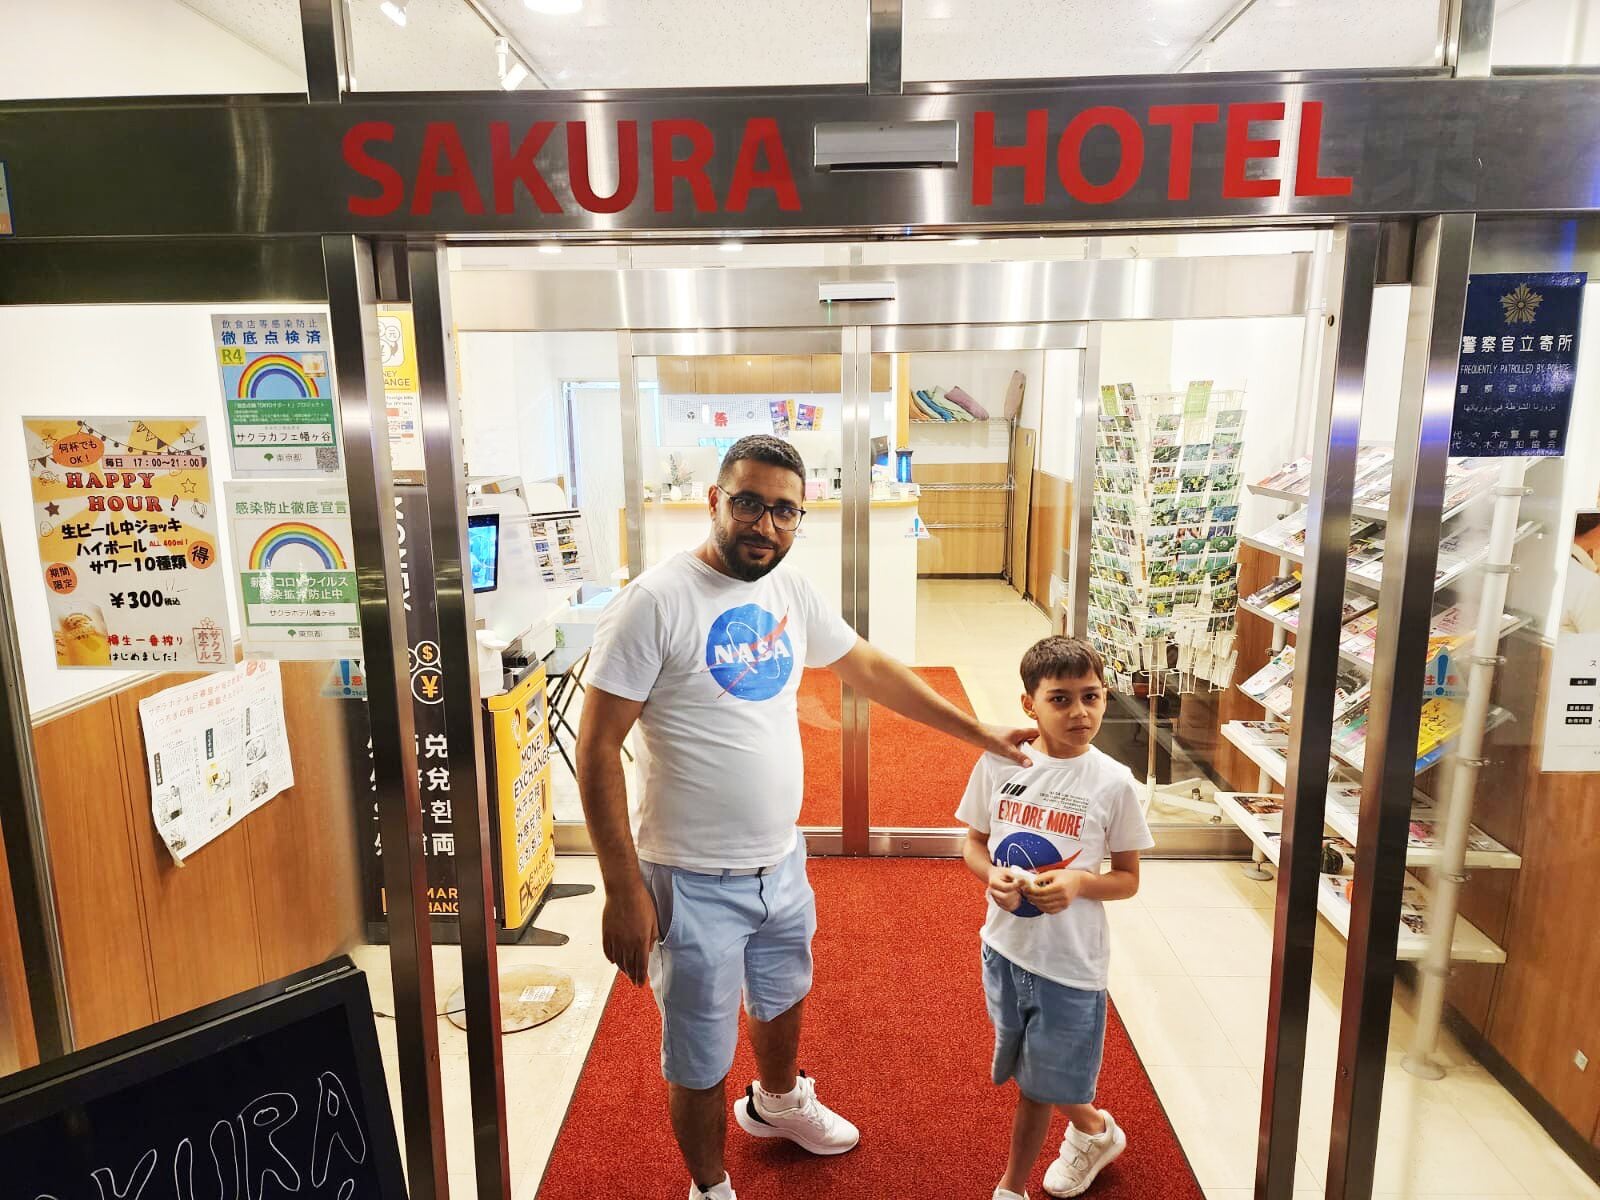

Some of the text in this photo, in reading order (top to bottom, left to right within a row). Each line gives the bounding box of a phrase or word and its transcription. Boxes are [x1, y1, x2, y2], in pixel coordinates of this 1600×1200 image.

[345, 101, 1353, 215] SAKURA HOTEL
[221, 330, 321, 345] 徹底点検済
[1462, 334, 1573, 354] 警察官立寄所
[222, 348, 242, 362] R4
[383, 370, 397, 378] NEY
[1460, 364, 1497, 374] FREQUENTLY
[1500, 364, 1534, 374] PATROLLED
[384, 378, 410, 387] ANGE
[237, 431, 331, 442] サクラカフェ幡ヶ谷
[58, 439, 98, 453] 何杯でも
[105, 458, 123, 468] 毎日
[65, 472, 155, 489] HAPPY
[235, 501, 347, 515] 感染防止徹底宣言
[61, 517, 182, 540] 生ビール中ジョッキ
[76, 538, 148, 557] ハイボール
[191, 545, 209, 564] 得
[89, 554, 187, 575] サワー10種類
[49, 566, 70, 578] 期間
[52, 578, 73, 590] 限定
[250, 576, 349, 588] 新コロウイルス
[714, 639, 791, 664] NASA
[522, 732, 543, 761] MONEY
[514, 747, 550, 798] EXCHANGE
[998, 799, 1047, 830] EXPLORE
[1046, 809, 1083, 838] MORE
[427, 887, 458, 899] MAR
